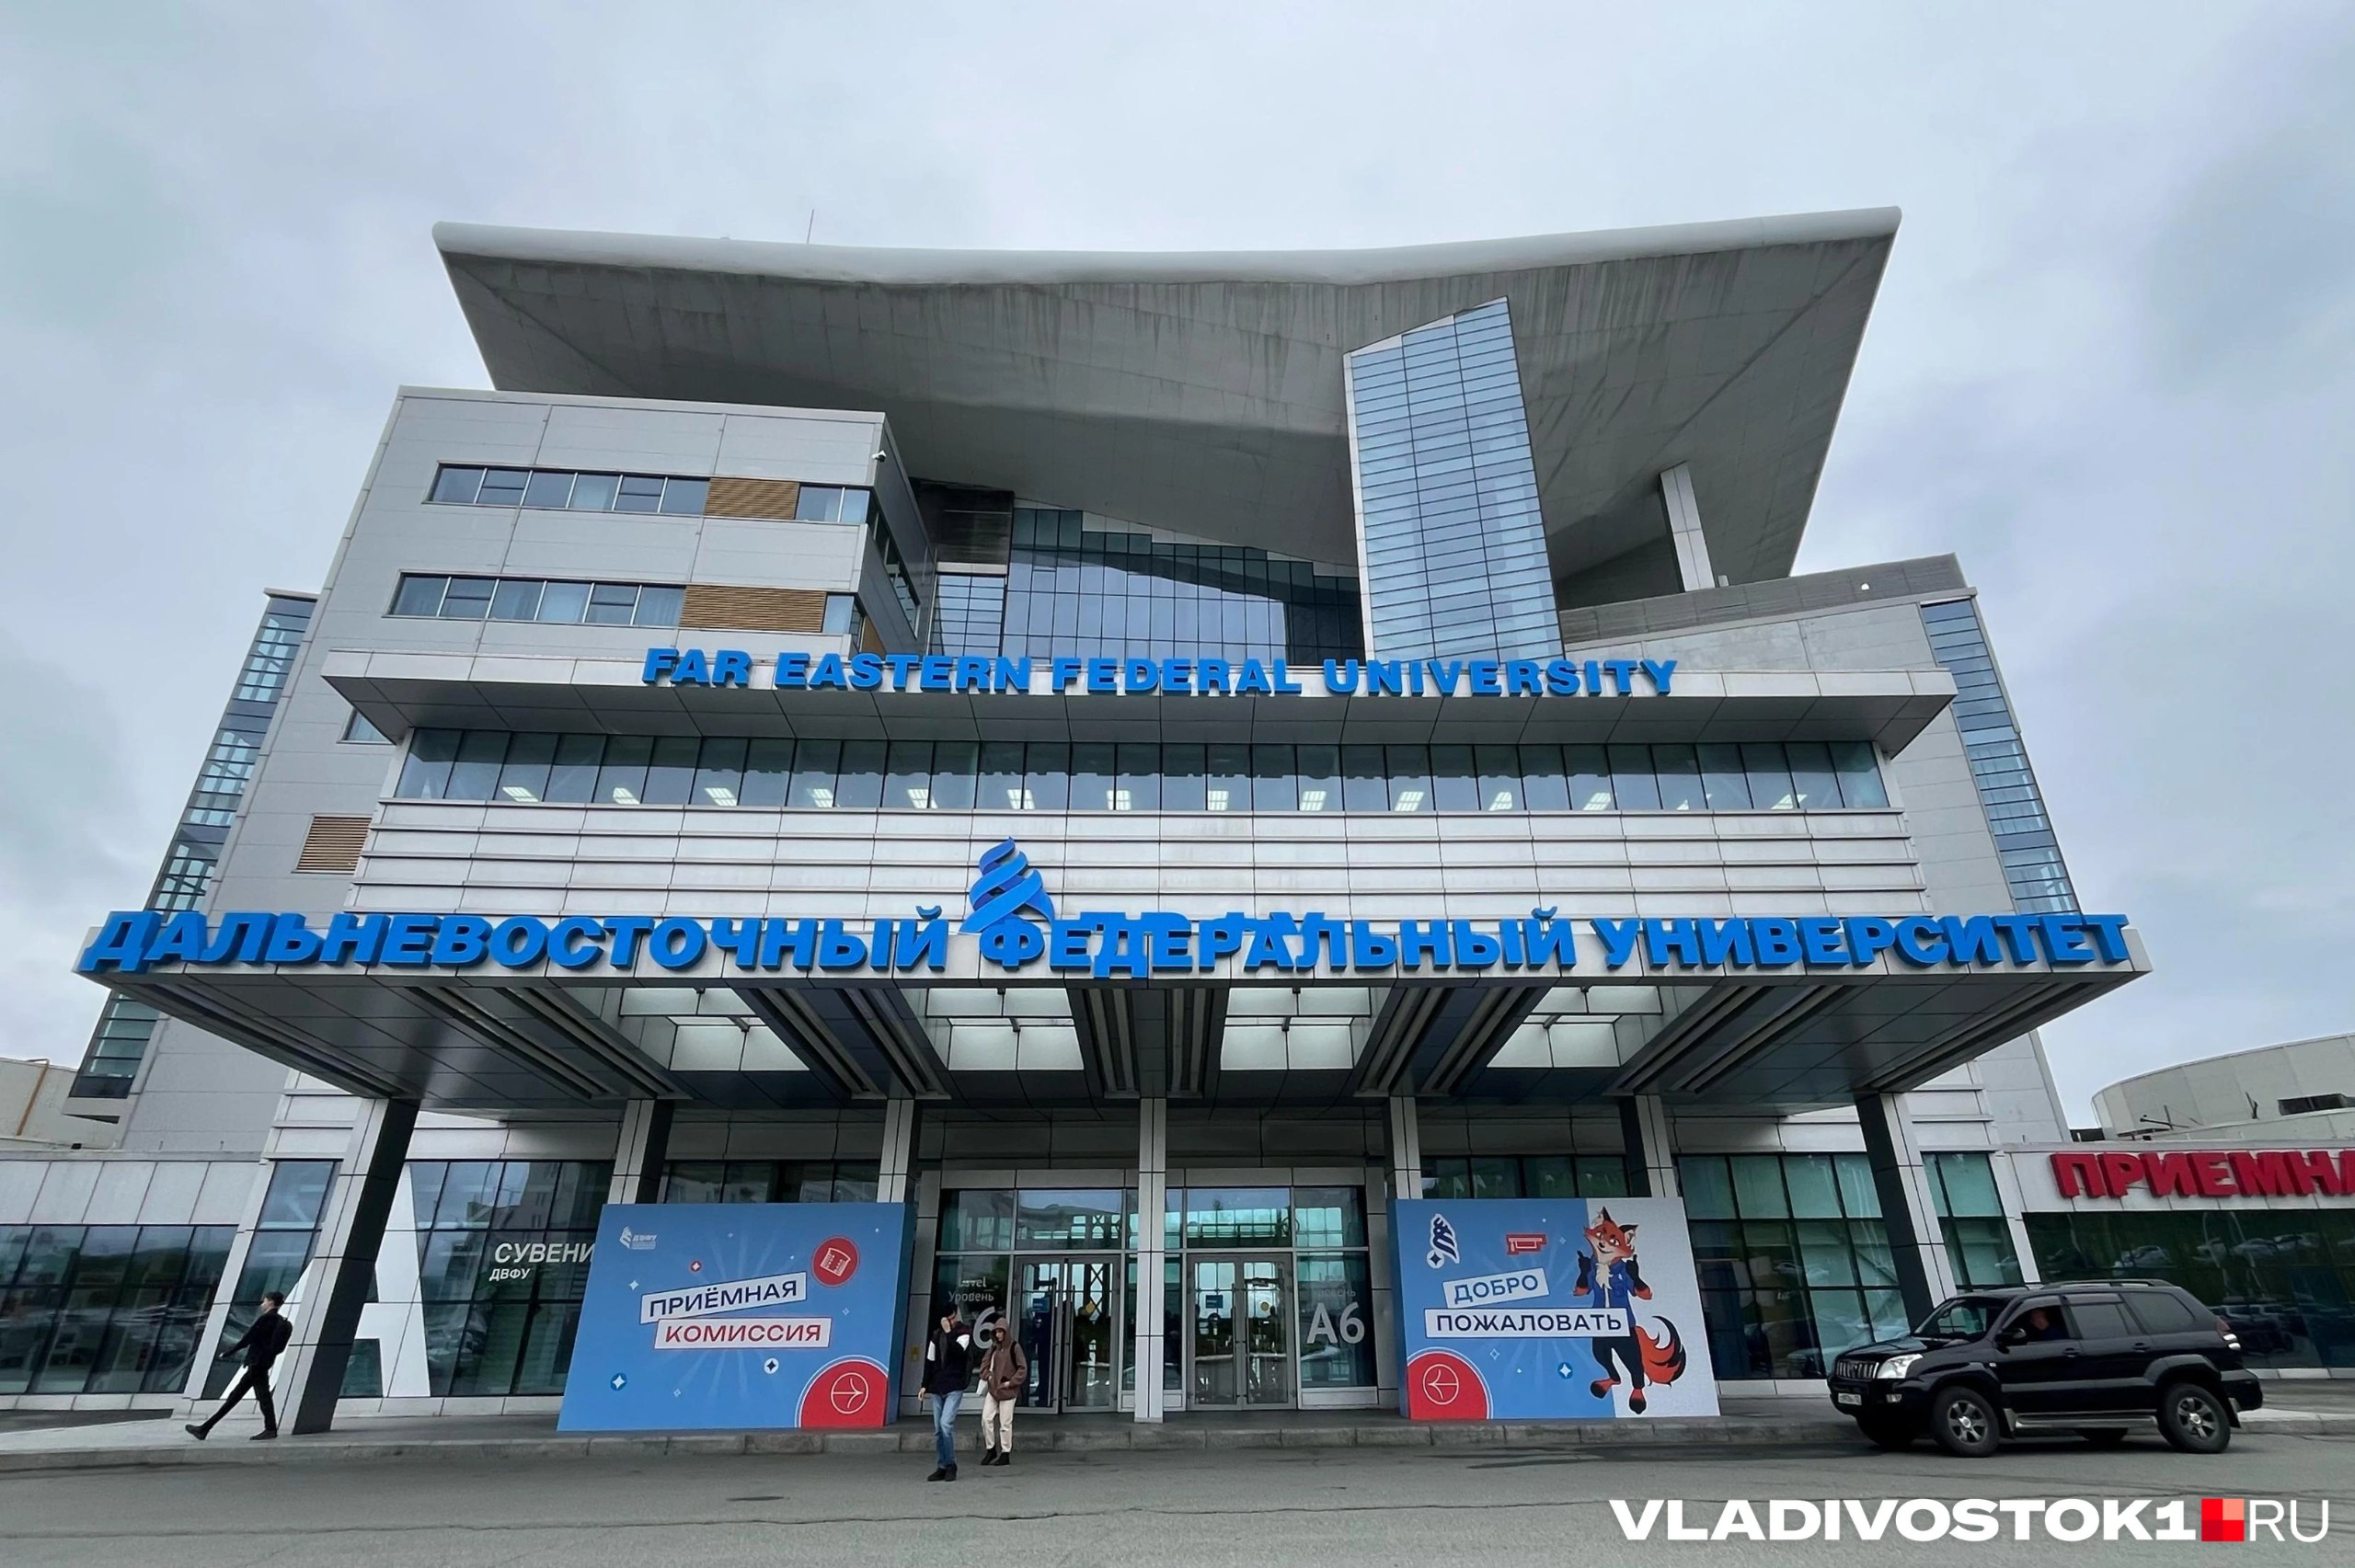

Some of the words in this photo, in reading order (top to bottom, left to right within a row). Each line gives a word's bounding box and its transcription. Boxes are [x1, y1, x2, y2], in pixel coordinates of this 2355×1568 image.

[642, 648, 752, 690] FAR
[775, 652, 1032, 692] EASTERN
[1052, 657, 1302, 693] FEDERAL
[1323, 658, 1678, 696] UNIVERSITY
[79, 905, 949, 972] ДАЛЬНЕВОСТОЧНЫЙ
[979, 905, 1577, 978] ФЕДЕРАЛЬНЫЙ
[1589, 913, 2131, 969] УНИВЕРСИТЕТ
[488, 1268, 531, 1281] ДВФУ
[649, 1279, 798, 1318] ПРИЁМНАЯ
[948, 1289, 994, 1305] Уровень
[1454, 1275, 1539, 1304] ДОБРО
[665, 1323, 821, 1343] КОМИССИЯ
[1436, 1313, 1623, 1333] ПОЖАЛОВАТЬ
